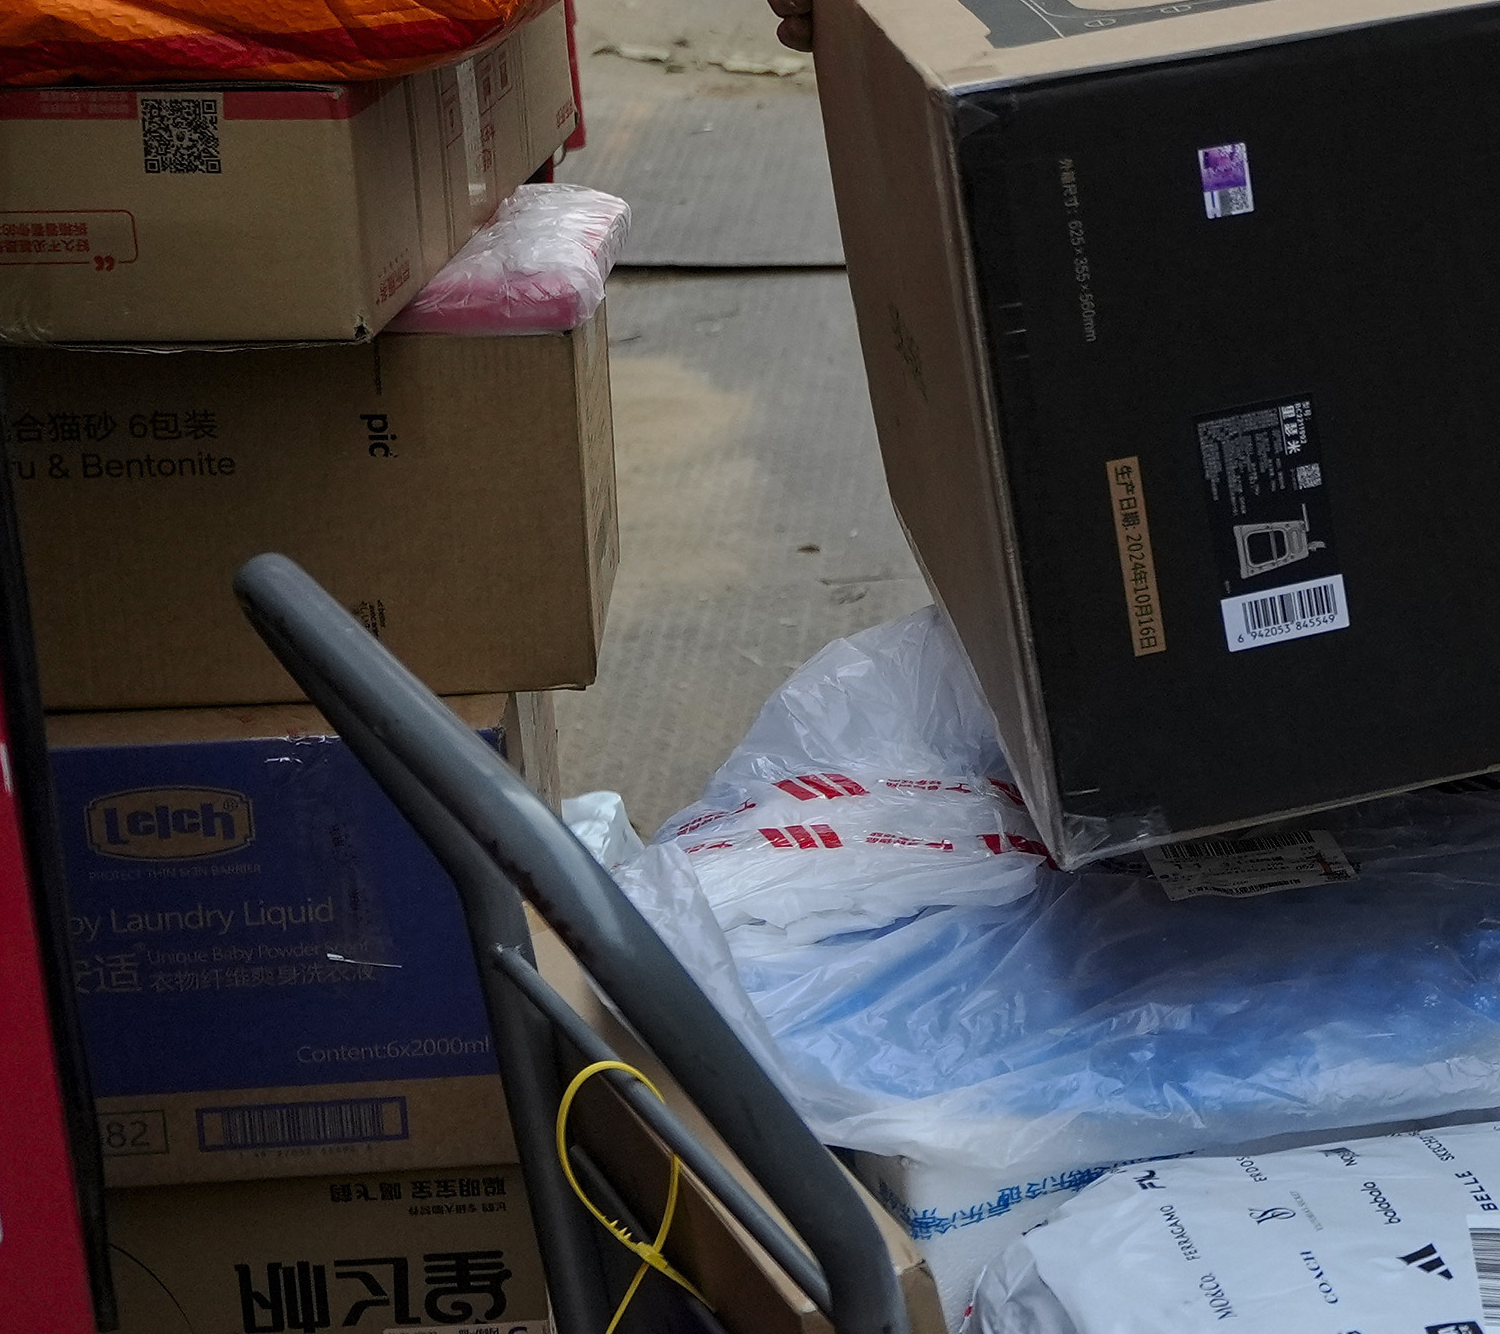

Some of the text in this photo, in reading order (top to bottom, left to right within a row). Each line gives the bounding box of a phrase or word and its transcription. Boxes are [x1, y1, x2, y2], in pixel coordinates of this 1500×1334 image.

[81, 453, 236, 479] Bentonite
[1124, 534, 1158, 651] 2024年10月16日
[111, 903, 235, 936] Laundry
[244, 896, 334, 932] Liquid
[1455, 1169, 1498, 1211] BELLE
[1159, 1204, 1200, 1261] FERRAGAMO
[1300, 1250, 1338, 1305] COACH
